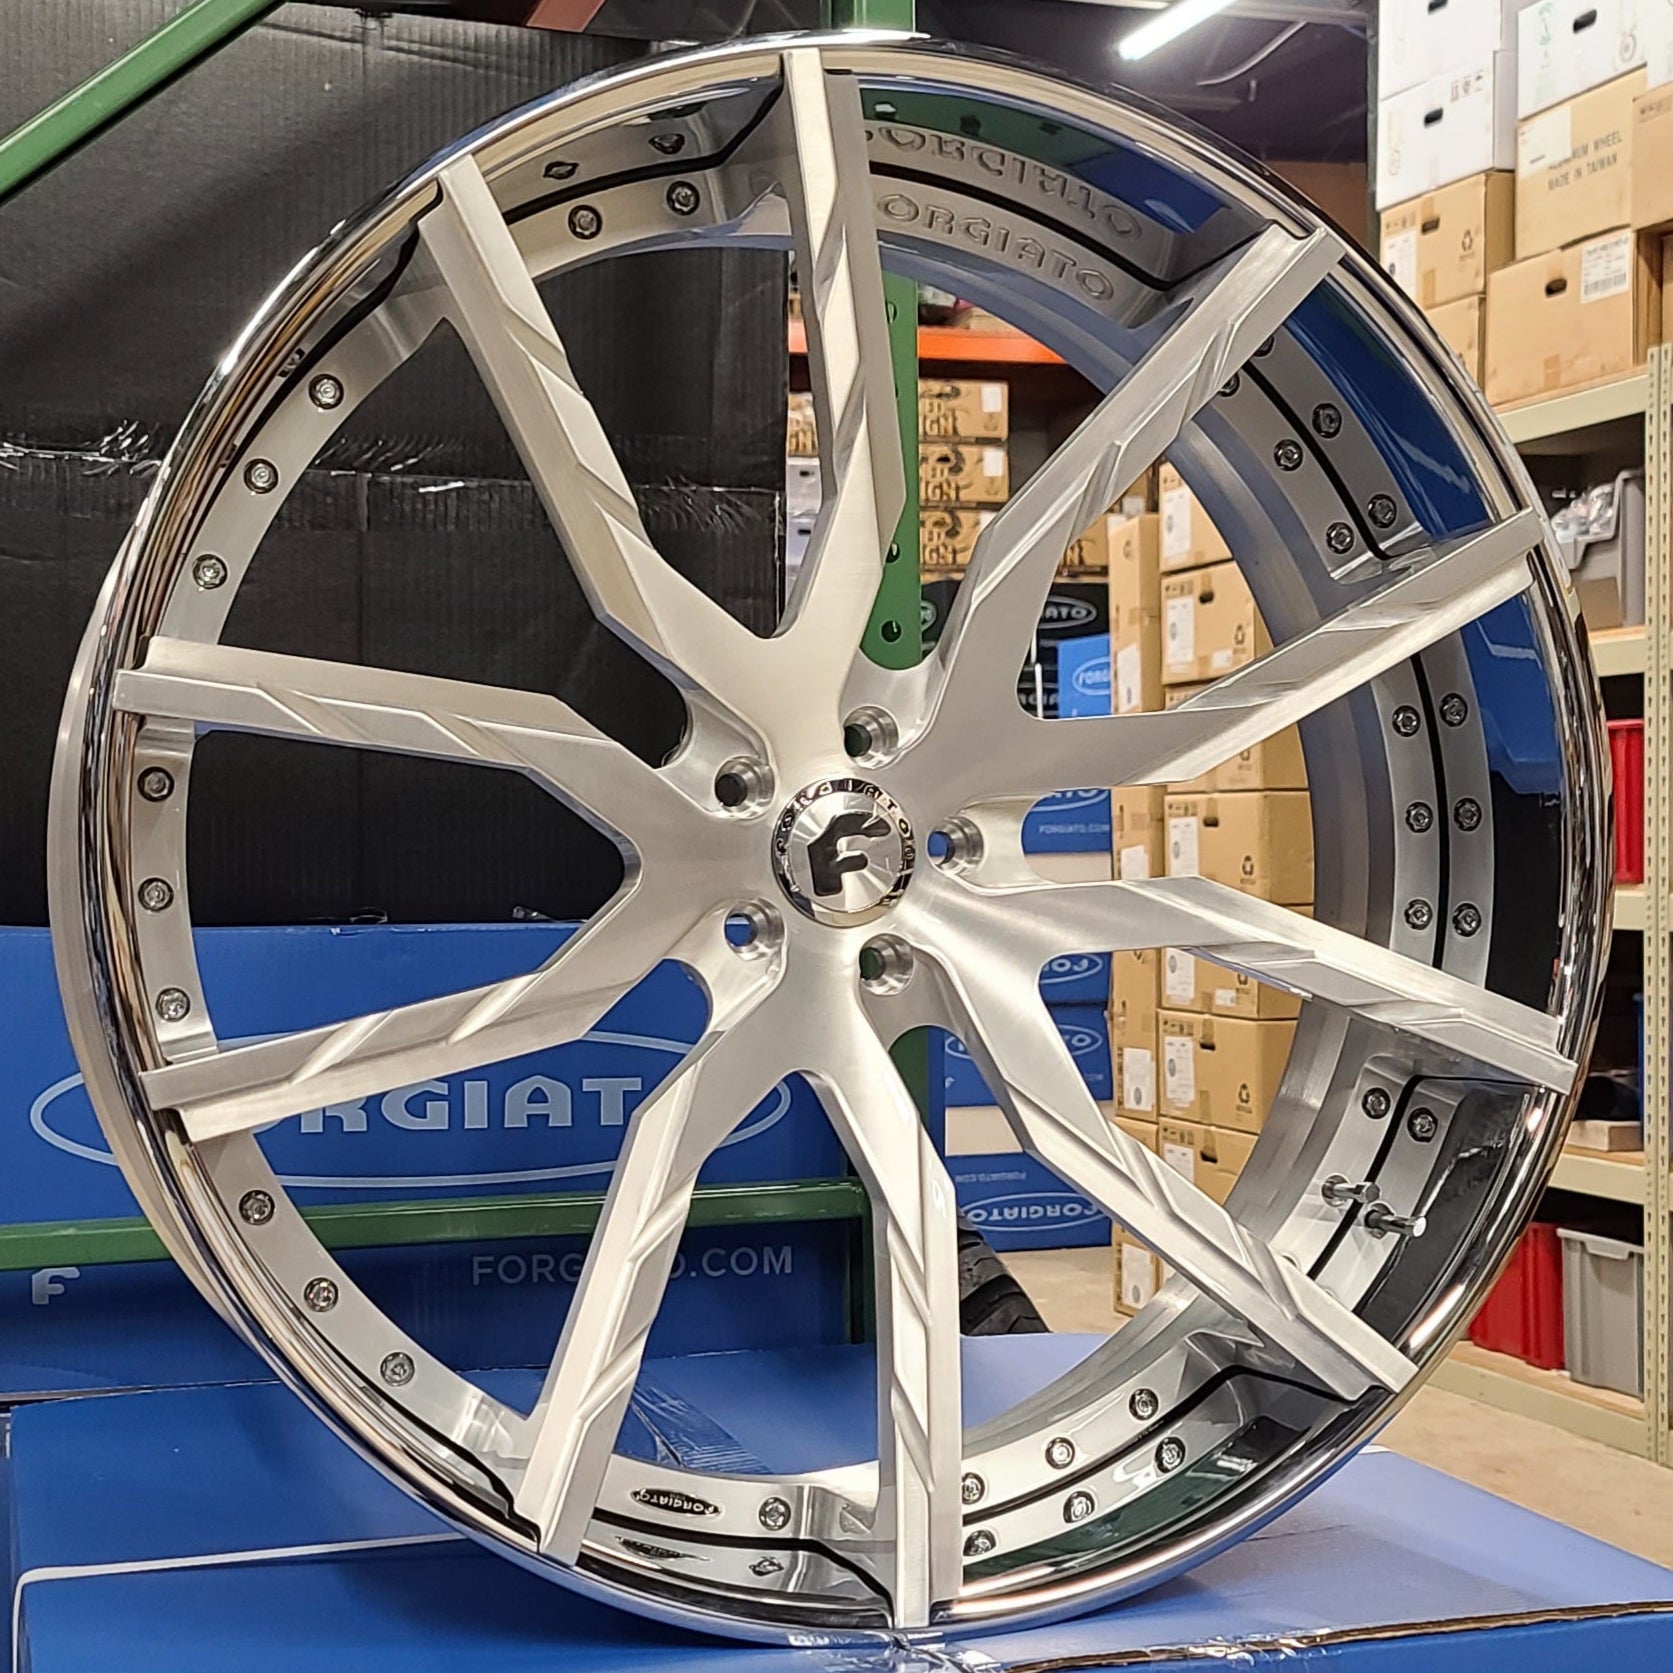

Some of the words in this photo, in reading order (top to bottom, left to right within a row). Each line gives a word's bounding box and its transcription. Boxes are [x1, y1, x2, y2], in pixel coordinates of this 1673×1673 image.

[1548, 172, 1570, 191] MADE
[1574, 167, 1583, 181] IN
[1587, 153, 1618, 174] TAIWAN
[878, 193, 1115, 300] ORGIATO
[253, 1075, 643, 1134] RGIAT
[31, 1266, 81, 1305] F
[472, 1245, 793, 1286] FORG.COM
